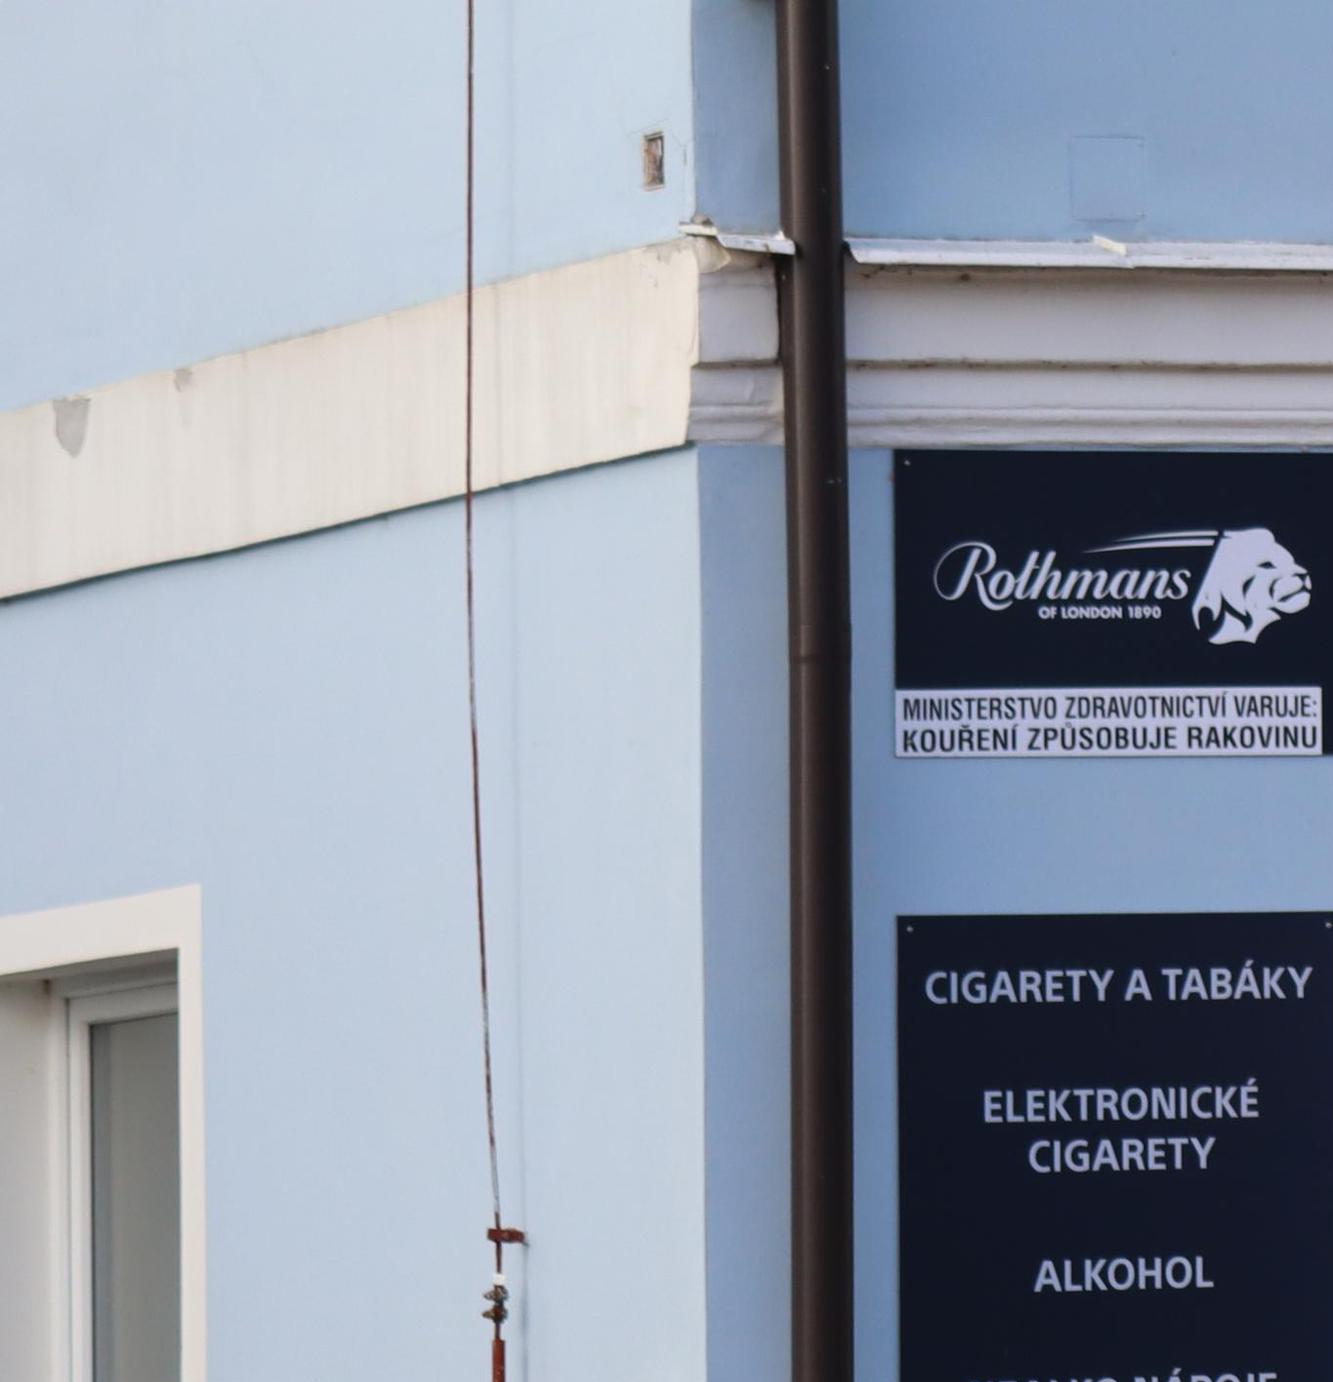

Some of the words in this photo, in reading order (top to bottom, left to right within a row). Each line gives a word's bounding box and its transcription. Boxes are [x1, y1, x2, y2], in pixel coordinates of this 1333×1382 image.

[933, 540, 1191, 610] Rothmans
[1038, 605, 1058, 620] OF
[1061, 605, 1122, 620] LONDON
[1127, 604, 1161, 619] 1890
[902, 695, 1058, 722] MINISTERSTVO
[1066, 691, 1227, 719] ZDRAVOTNICTVÍ
[1233, 694, 1318, 719] VARUJE:
[902, 720, 1018, 754] KOUŘENÍ
[1027, 719, 1178, 751] ZPŮSOBUJE
[1186, 725, 1318, 750] RAKOVINU
[925, 969, 1114, 1005] CIGARETY
[1124, 969, 1152, 1001] A
[1161, 960, 1313, 1000] TABÁKY
[983, 1078, 1259, 1123] ELEKTRONICKÉ
[1028, 1136, 1216, 1173] CIGARETY
[1034, 1255, 1214, 1292] ALKOHOL
